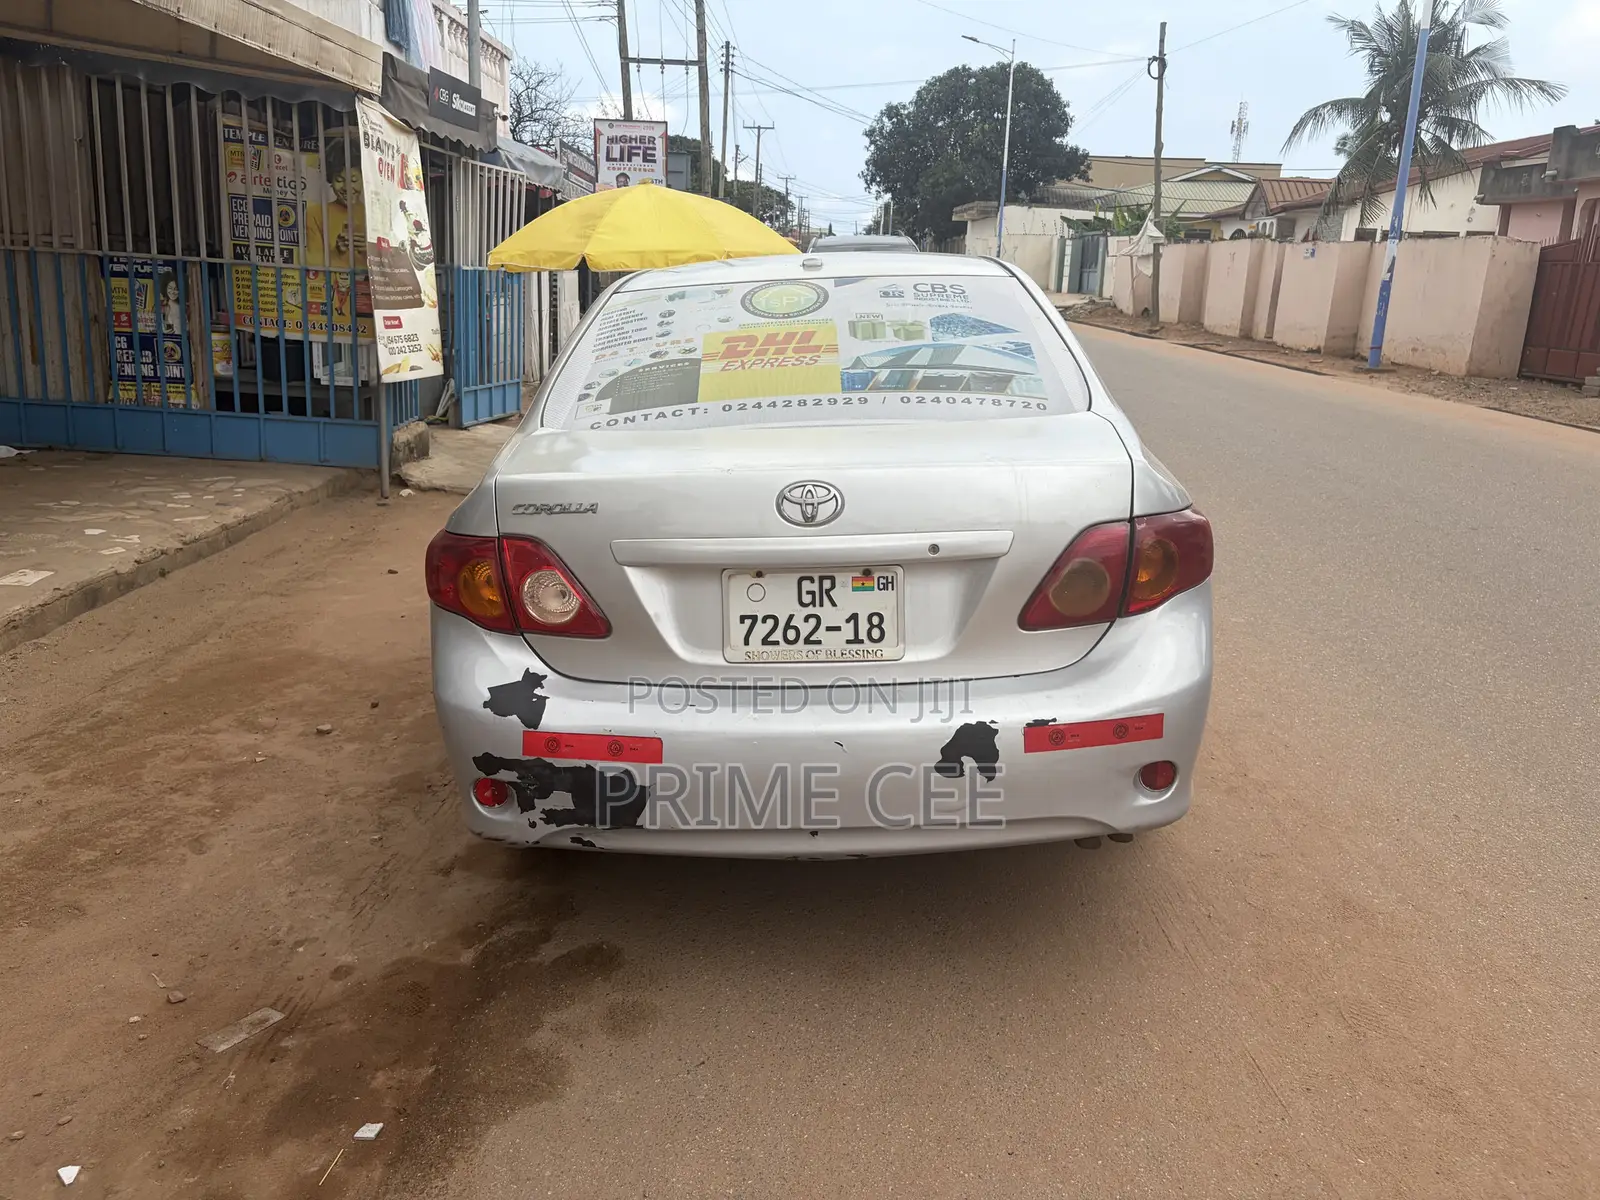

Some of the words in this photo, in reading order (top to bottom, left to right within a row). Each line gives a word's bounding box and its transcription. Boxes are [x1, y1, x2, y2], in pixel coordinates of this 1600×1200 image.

[606, 135, 657, 145] HIGHER
[605, 145, 657, 164] LIFE
[233, 212, 272, 228] PREAID
[234, 224, 272, 240] VENING
[276, 229, 299, 243] OINT
[912, 283, 967, 295] CBS
[913, 292, 969, 300] SUPREME
[620, 312, 644, 321] AGENCY
[112, 335, 127, 349] CG
[606, 335, 633, 344] RENTALS
[719, 330, 824, 360] DHL
[720, 355, 821, 371] EXPRESS
[590, 407, 708, 430] CONTACT:
[721, 396, 869, 413] 0244282929
[899, 396, 1047, 411] 0240478720
[512, 502, 599, 515] COROLLA
[797, 575, 838, 608] GR
[877, 576, 895, 591] GH
[739, 612, 886, 646] 7262-18
[744, 650, 803, 661] SHOWERS
[805, 650, 819, 661] OF
[825, 648, 884, 660] BLESSING
